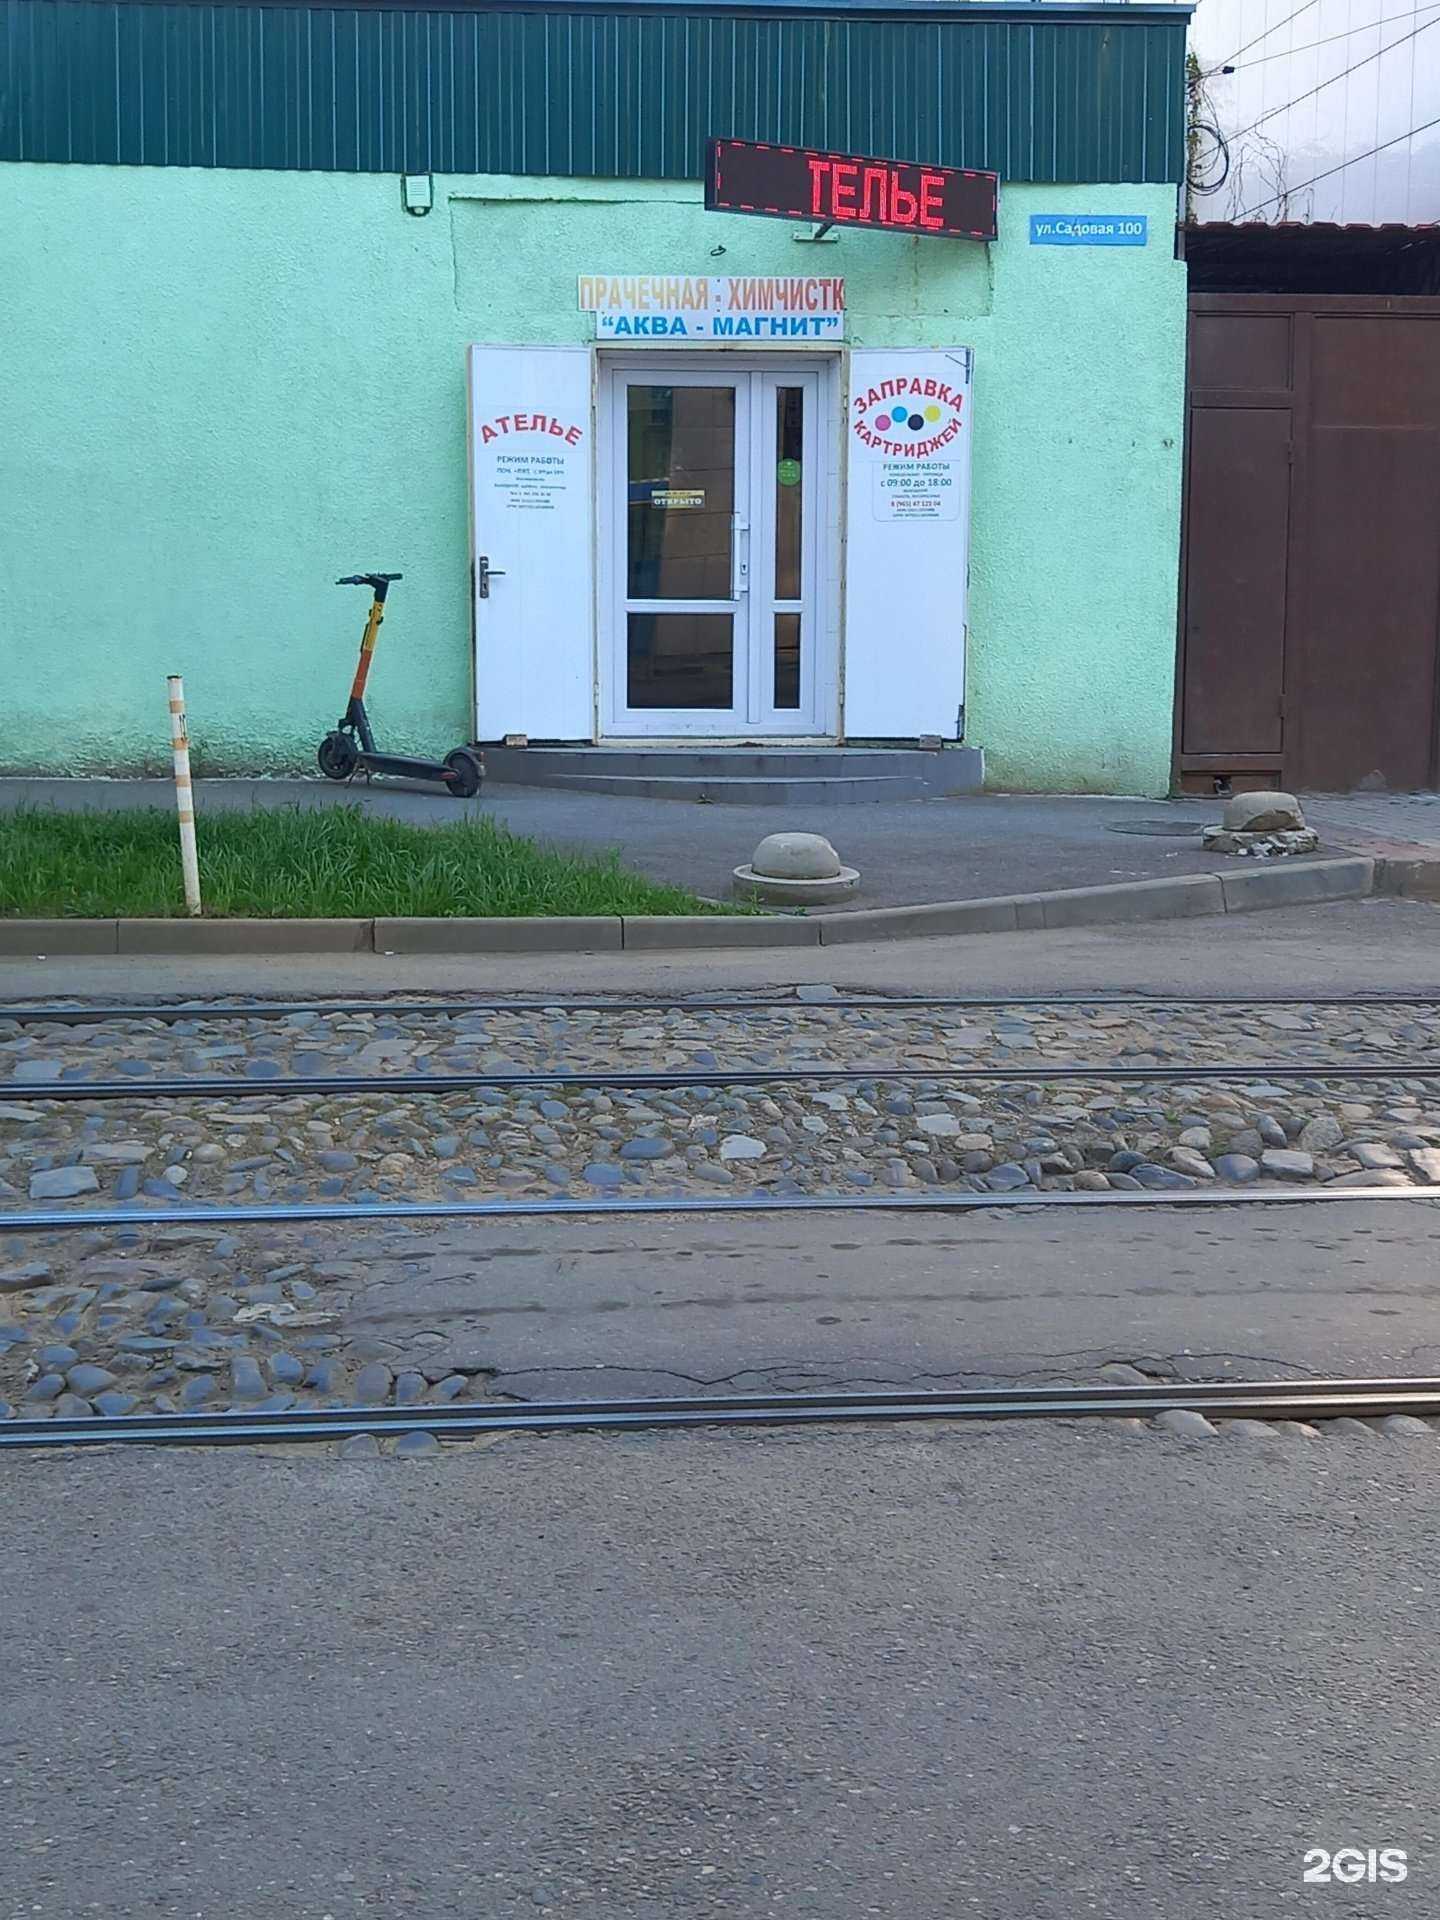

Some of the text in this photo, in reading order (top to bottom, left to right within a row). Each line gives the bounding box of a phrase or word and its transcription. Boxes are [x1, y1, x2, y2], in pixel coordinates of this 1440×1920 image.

[808, 159, 945, 227] ТЕЛЬЕ
[1035, 221, 1143, 237] ул.Садовая 100
[580, 278, 709, 310] ПРАЧЕЧНАЯ
[728, 278, 845, 311] ХИМЧИСТК
[853, 377, 964, 415] ЗАПРАВКА
[481, 413, 584, 447] АТЕЛЬЕ
[853, 417, 963, 460] КАРТРИДЖЕЙ
[497, 455, 565, 465] РЕЖИМ РАБОТЫ
[887, 478, 912, 487] 09:00
[913, 480, 926, 488] до
[927, 478, 952, 487] 18:00
[654, 497, 702, 505] ОТКРЫТО
